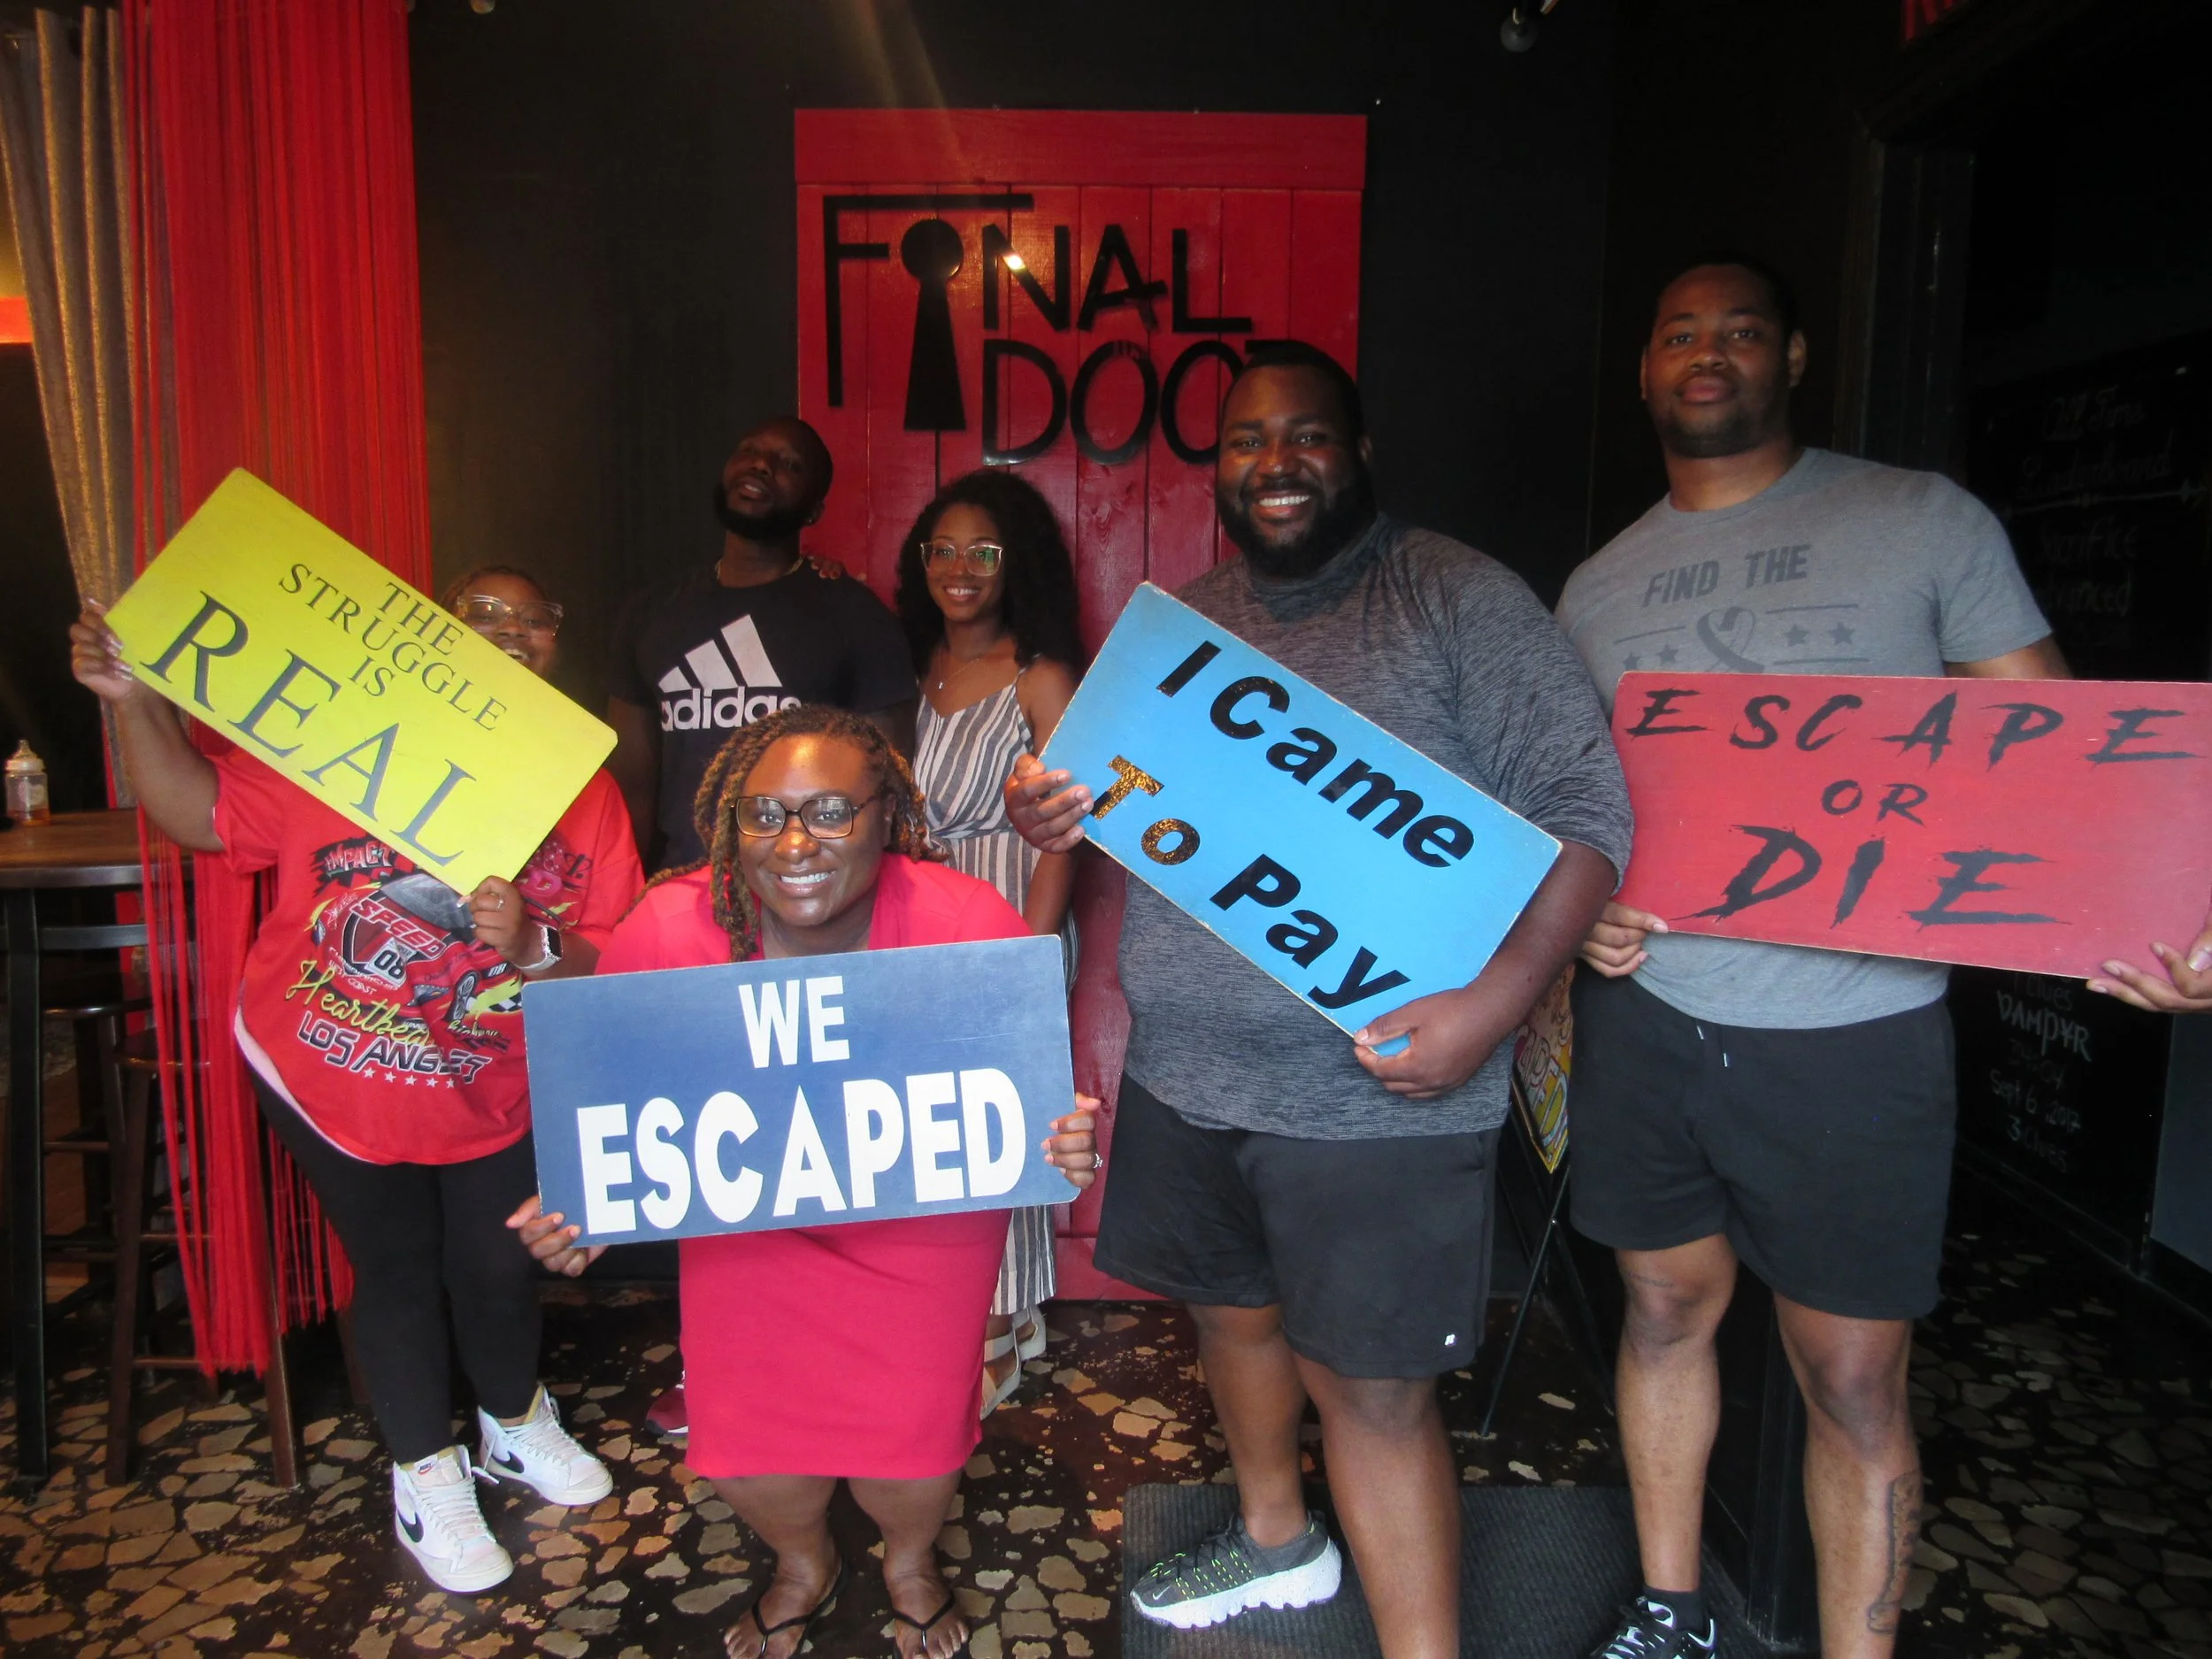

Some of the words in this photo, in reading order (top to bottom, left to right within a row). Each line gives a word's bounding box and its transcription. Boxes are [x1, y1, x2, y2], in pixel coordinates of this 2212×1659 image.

[981, 339, 1294, 466] DOO
[380, 581, 464, 656] THE
[1641, 560, 1720, 608] FIND
[1744, 543, 1811, 588] THE
[278, 563, 508, 732] STRUGGLE
[349, 656, 396, 697] IS
[140, 590, 477, 868] REAL
[1156, 641, 1222, 698] I
[1209, 676, 1475, 868] Came
[1626, 688, 2207, 772] ESCAPE
[1821, 780, 1929, 827] OR
[1089, 755, 1201, 865] To
[1209, 854, 1412, 1010] Pay
[1668, 824, 2072, 933] DIE
[349, 897, 447, 960] SPEED
[295, 1010, 360, 1067] LOS
[738, 975, 850, 1069] WE
[577, 1067, 1026, 1235] ESCAPED
